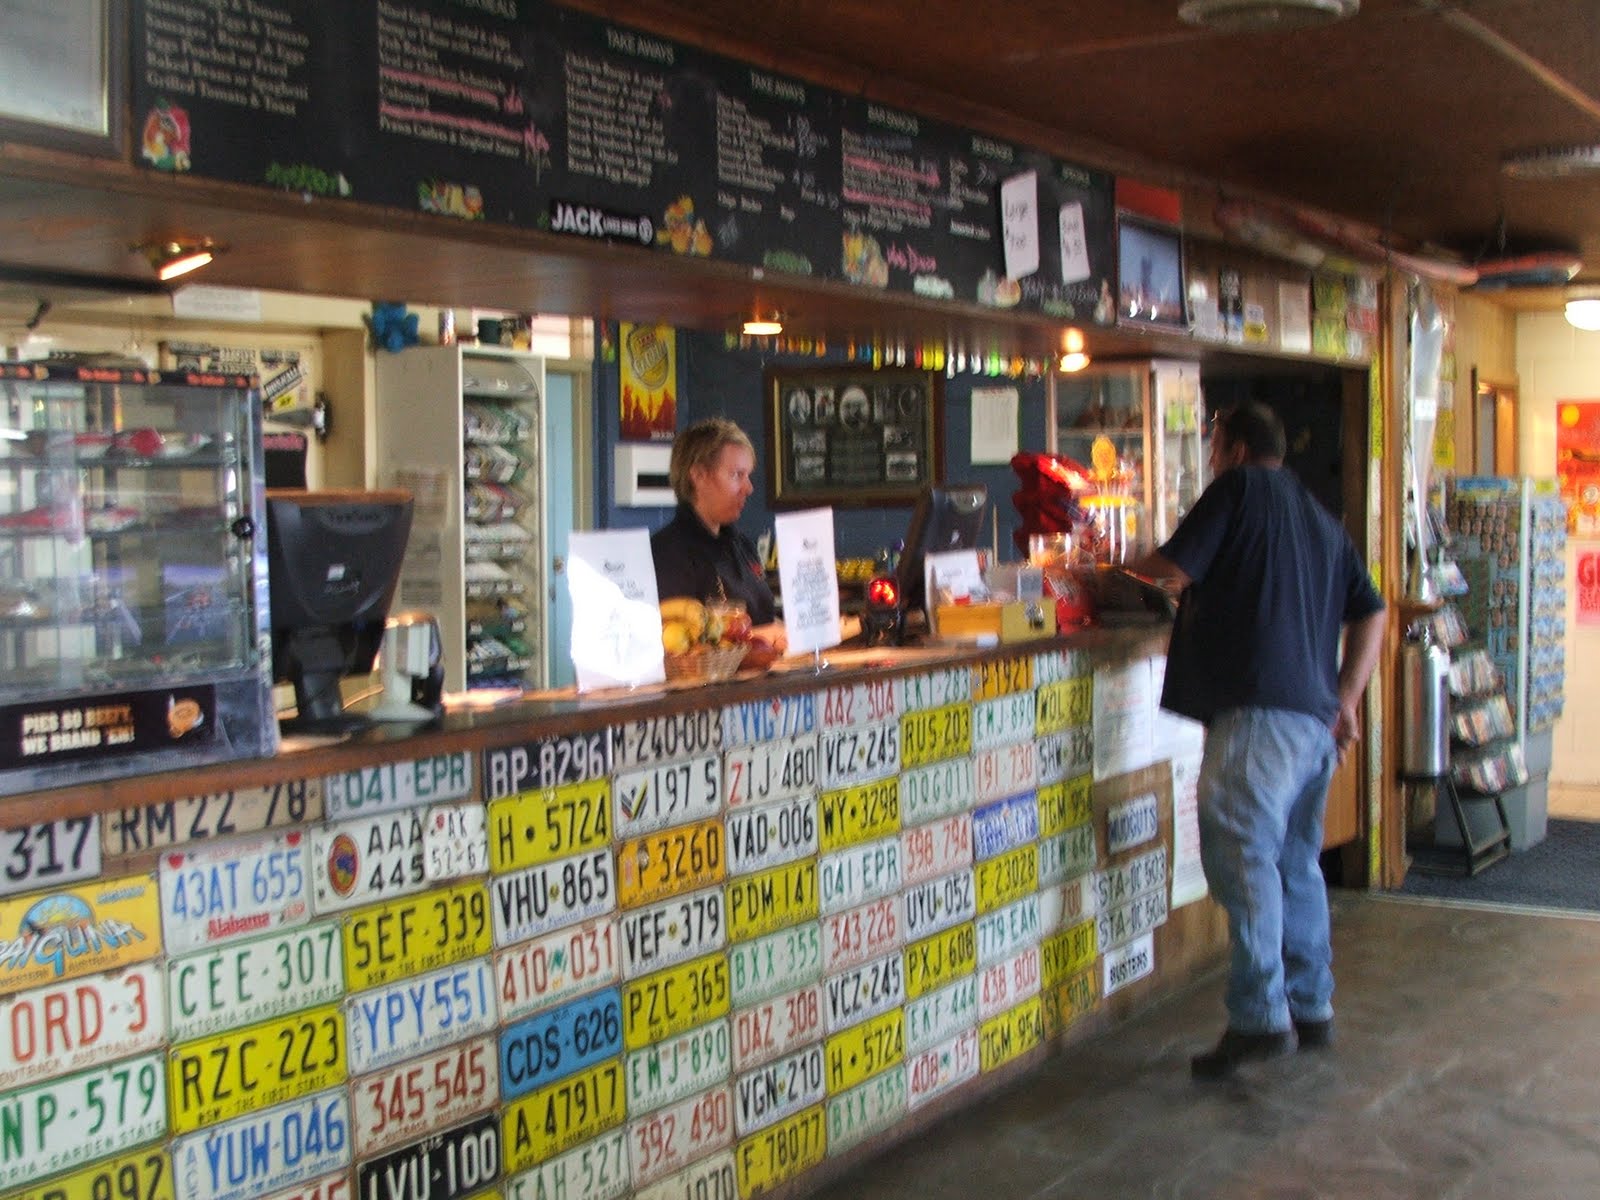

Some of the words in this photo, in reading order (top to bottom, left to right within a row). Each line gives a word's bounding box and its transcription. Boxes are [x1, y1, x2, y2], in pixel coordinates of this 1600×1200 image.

[551, 201, 604, 237] JACK
[4, 815, 94, 882] 317
[368, 816, 423, 858] AAA
[172, 860, 241, 922] 43AT
[252, 848, 304, 906] 655
[369, 854, 424, 893] 445
[497, 870, 548, 929] VHU
[562, 852, 609, 910] 865
[207, 912, 271, 940] Alabama
[624, 909, 667, 963] VEF
[680, 894, 720, 947] 379
[502, 946, 548, 1004] 410
[569, 923, 613, 981] 031
[788, 1050, 821, 1101] 210
